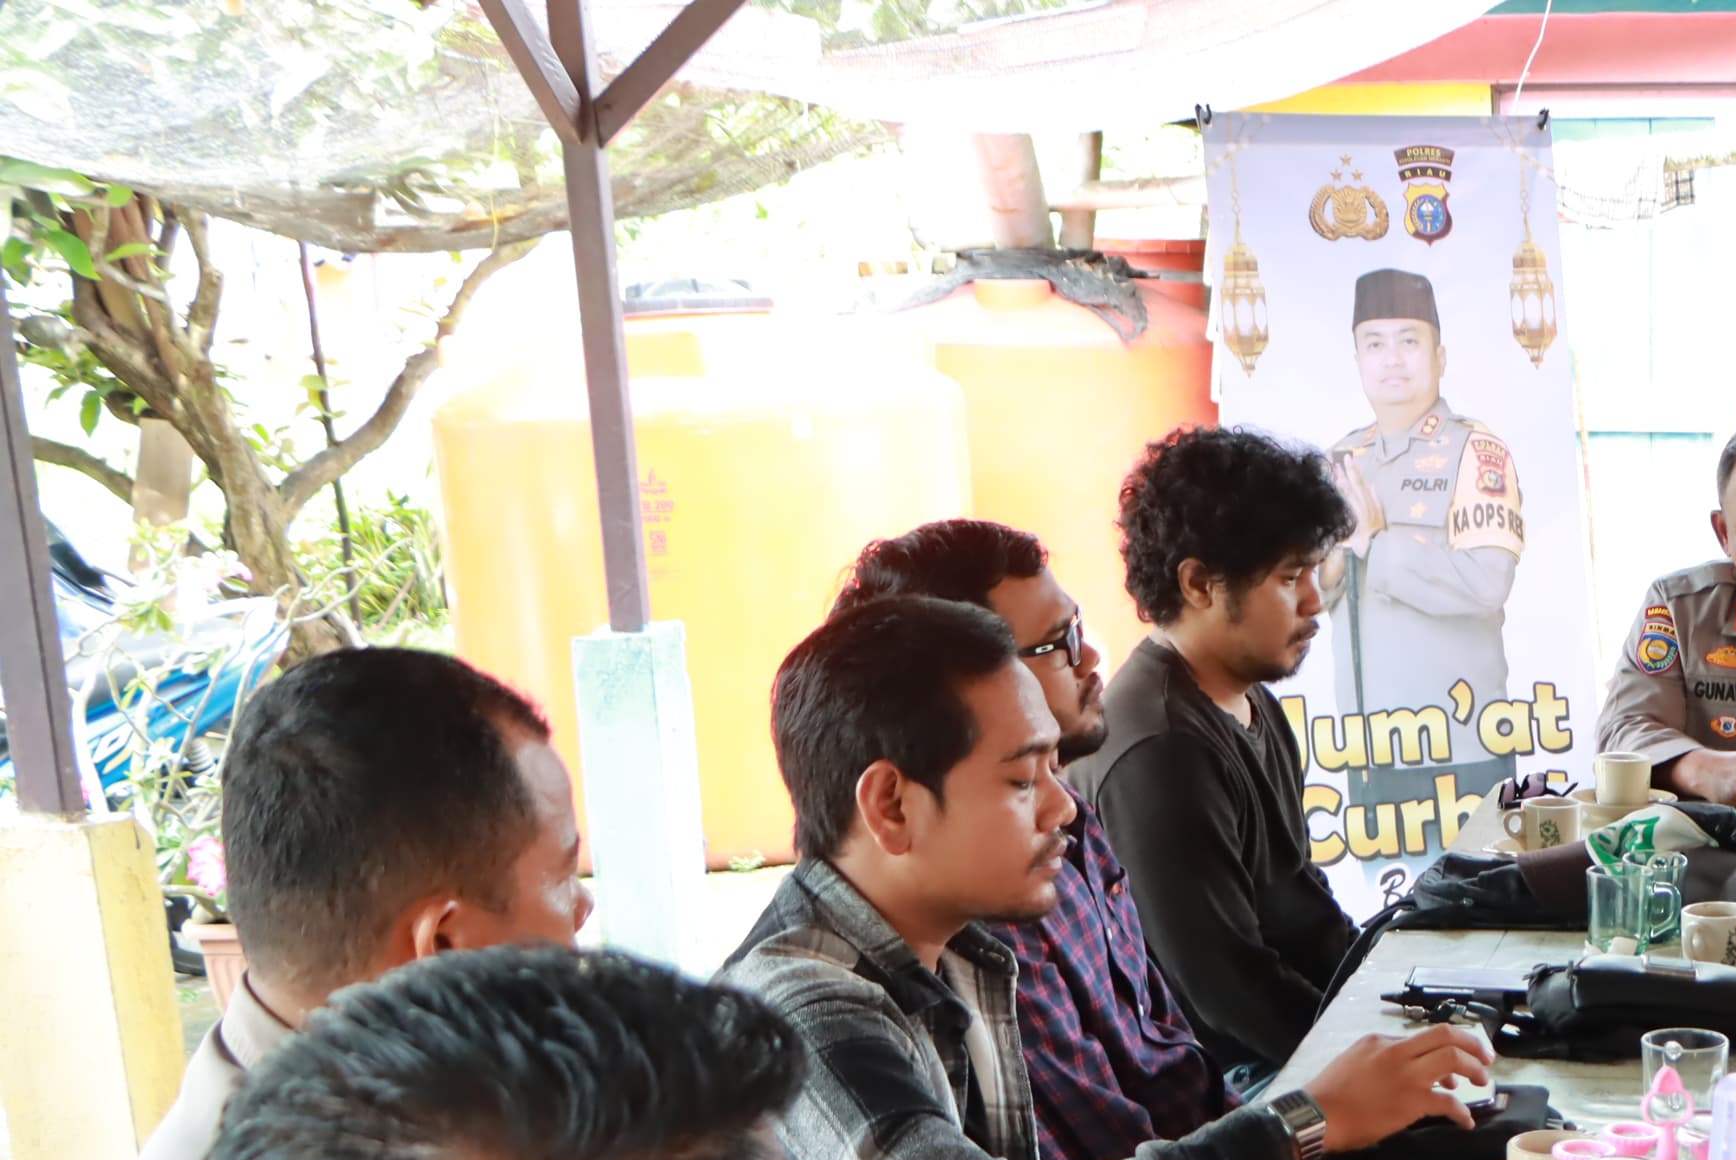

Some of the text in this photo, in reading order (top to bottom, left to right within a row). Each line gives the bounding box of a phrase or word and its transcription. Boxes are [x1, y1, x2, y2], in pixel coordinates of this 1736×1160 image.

[1406, 147, 1441, 157] POLRES
[1405, 168, 1446, 178] RIAU
[1400, 478, 1448, 492] POLRI
[1453, 506, 1470, 537] KA
[1473, 503, 1505, 529] OPS
[1648, 624, 1675, 636] BINMA
[1302, 769, 1568, 867] Curh
